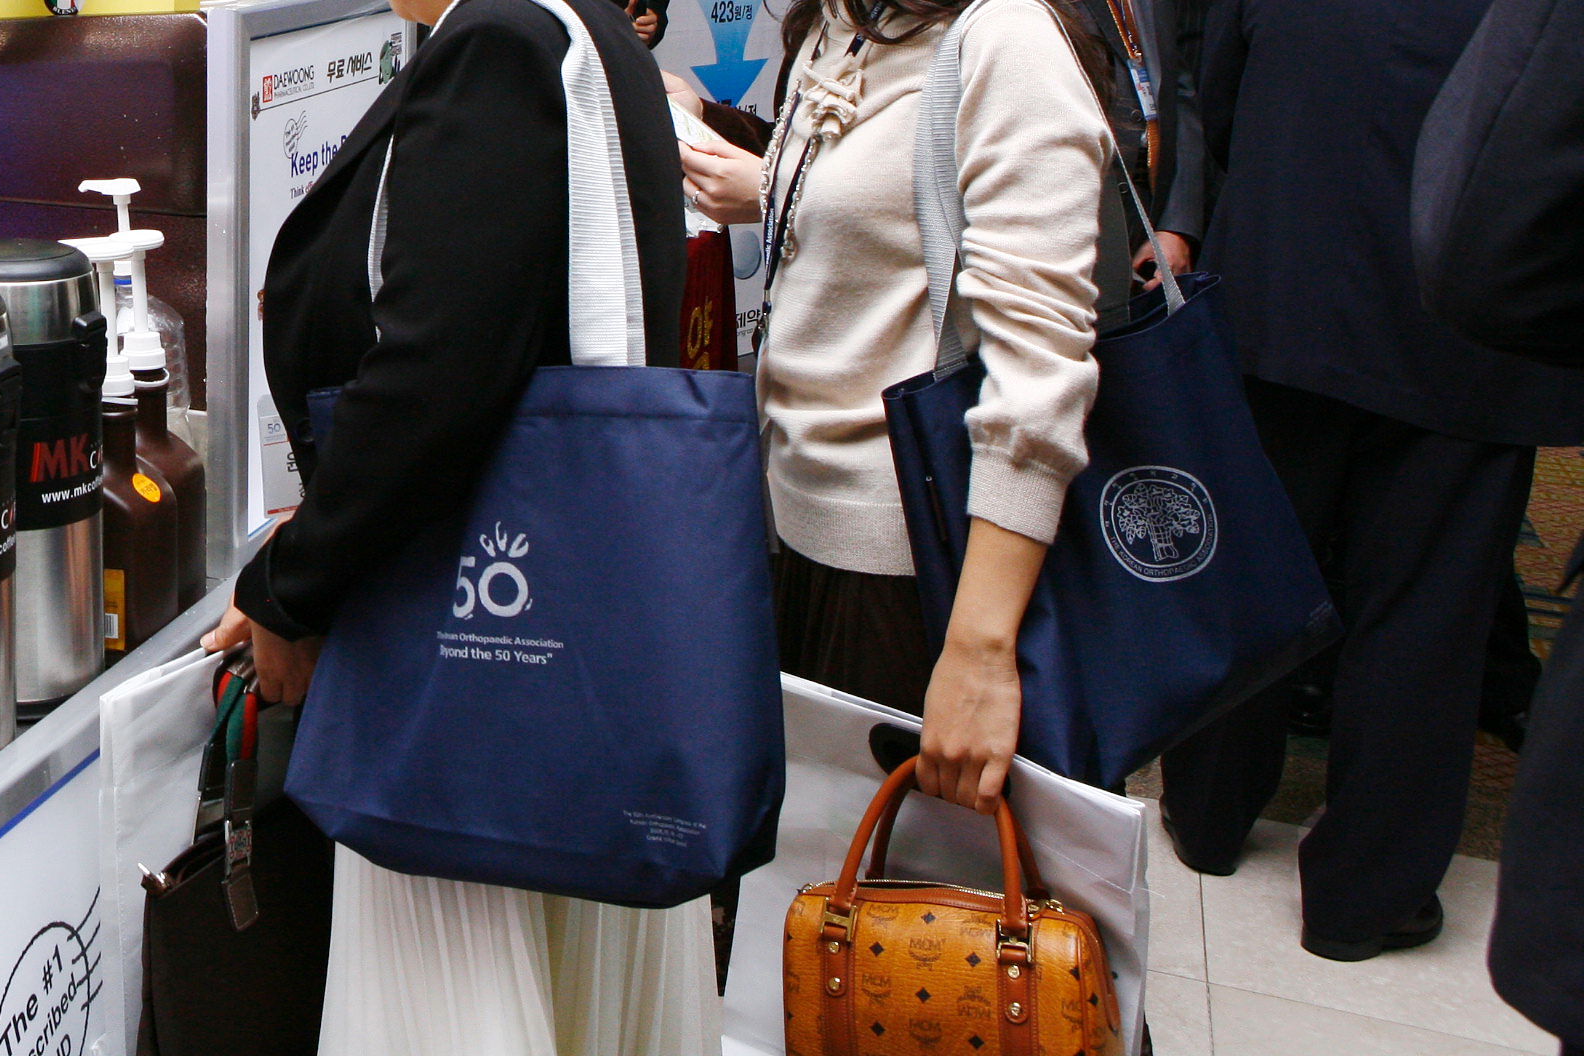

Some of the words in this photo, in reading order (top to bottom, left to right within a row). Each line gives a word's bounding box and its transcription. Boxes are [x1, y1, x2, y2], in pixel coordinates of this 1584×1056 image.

[274, 65, 314, 89] DAEWOONG
[290, 148, 319, 178] Keep
[321, 140, 338, 167] the
[470, 647, 492, 660] the
[495, 650, 510, 661] 50
[514, 637, 564, 648] Association
[0, 993, 39, 1056] The
[42, 944, 63, 995] #1
